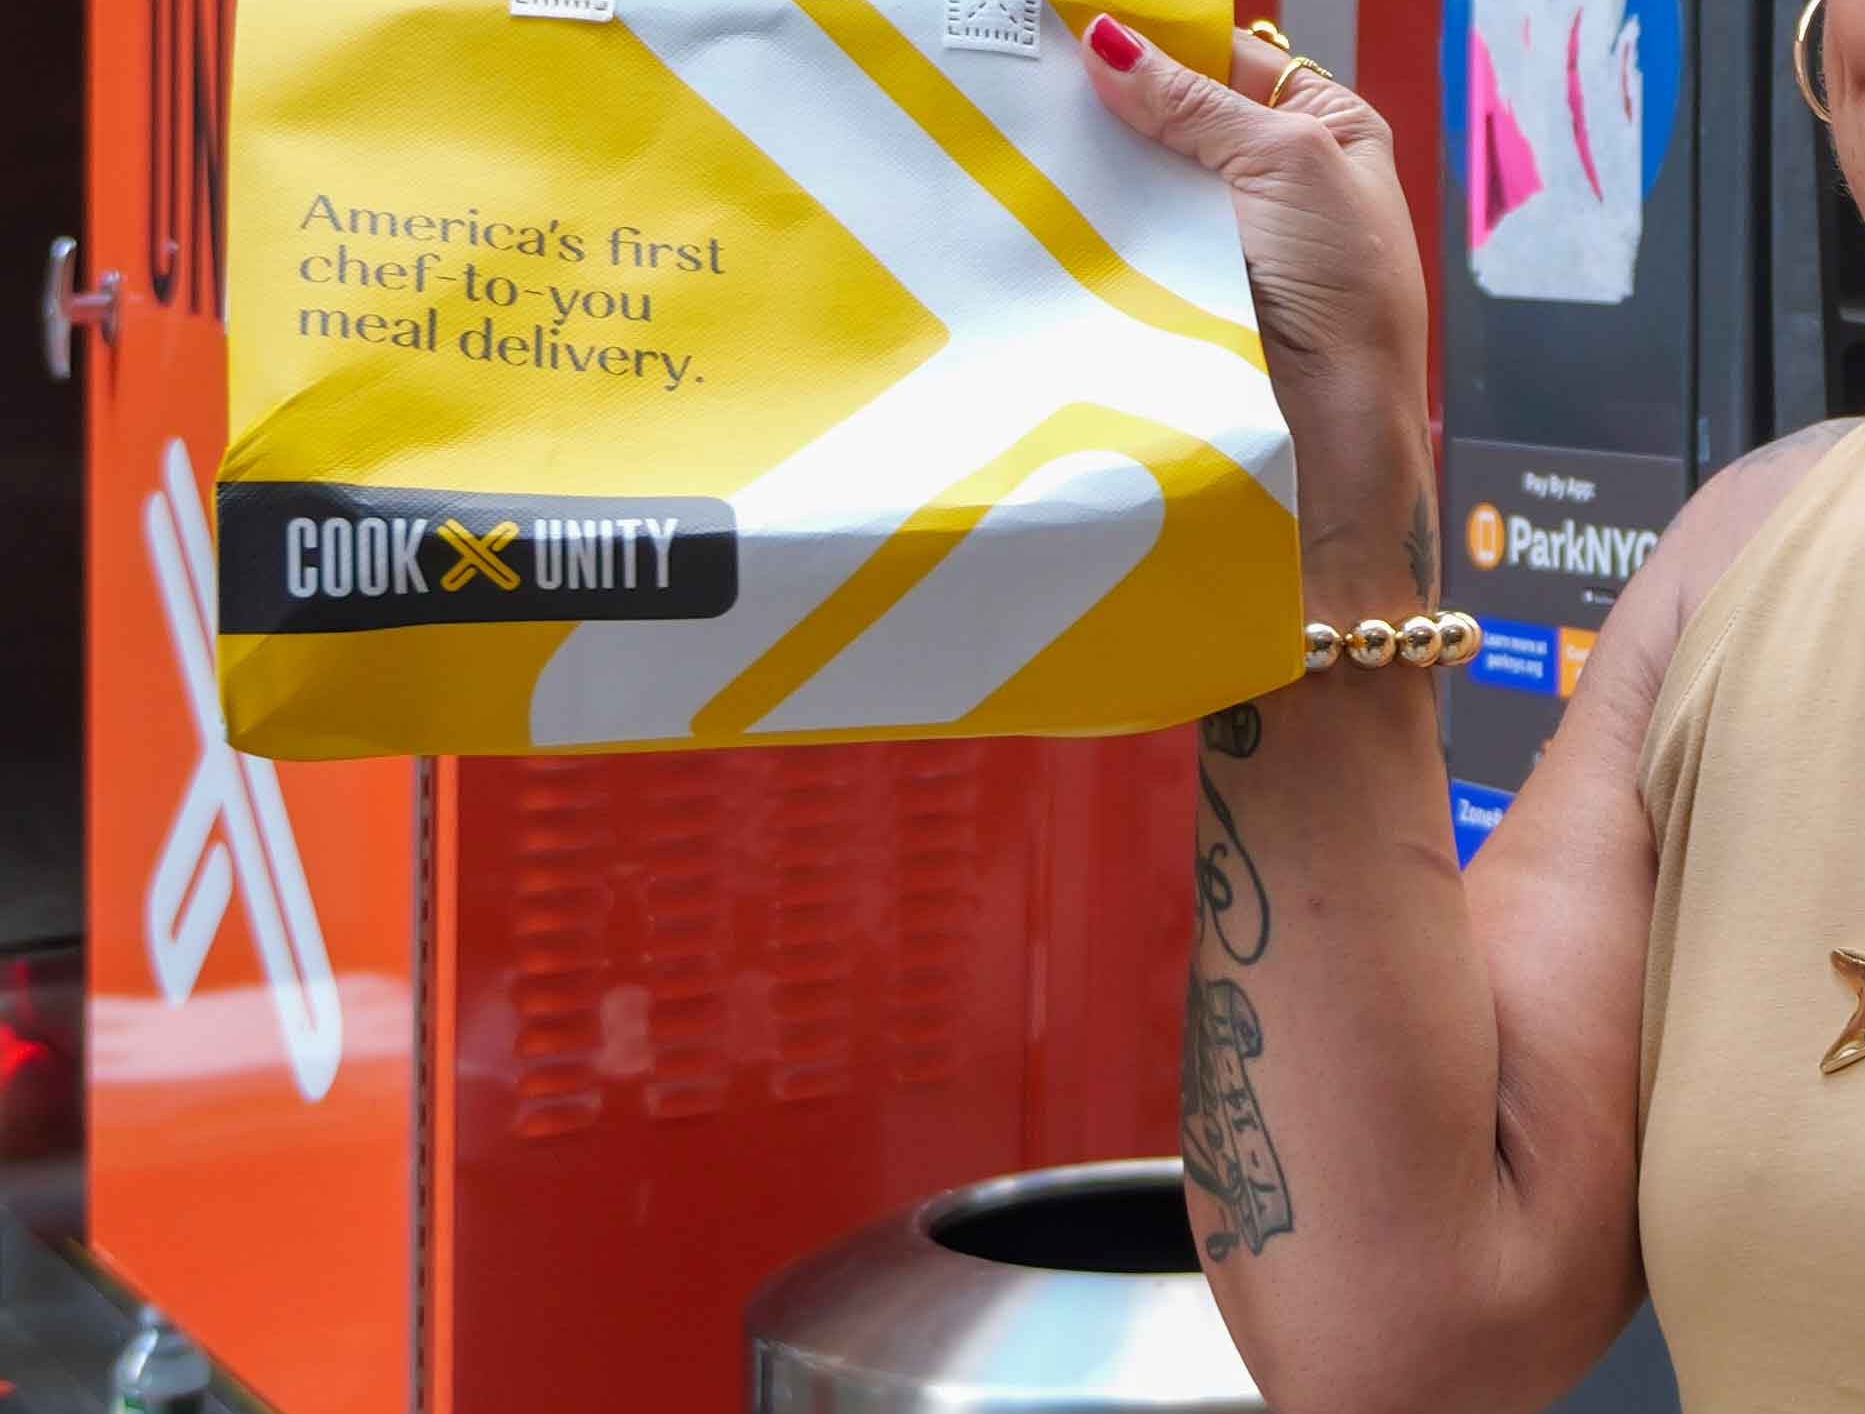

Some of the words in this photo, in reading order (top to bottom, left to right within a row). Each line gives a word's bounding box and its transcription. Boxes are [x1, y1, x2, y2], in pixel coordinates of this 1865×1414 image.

[299, 193, 587, 264] America's
[607, 225, 728, 275] first
[299, 243, 653, 326] chef-to-you
[299, 306, 438, 353] meal
[457, 317, 706, 392] delivery.
[286, 516, 431, 598] COOK
[533, 517, 680, 590] UNITY
[1507, 514, 1658, 579] ParkNYC
